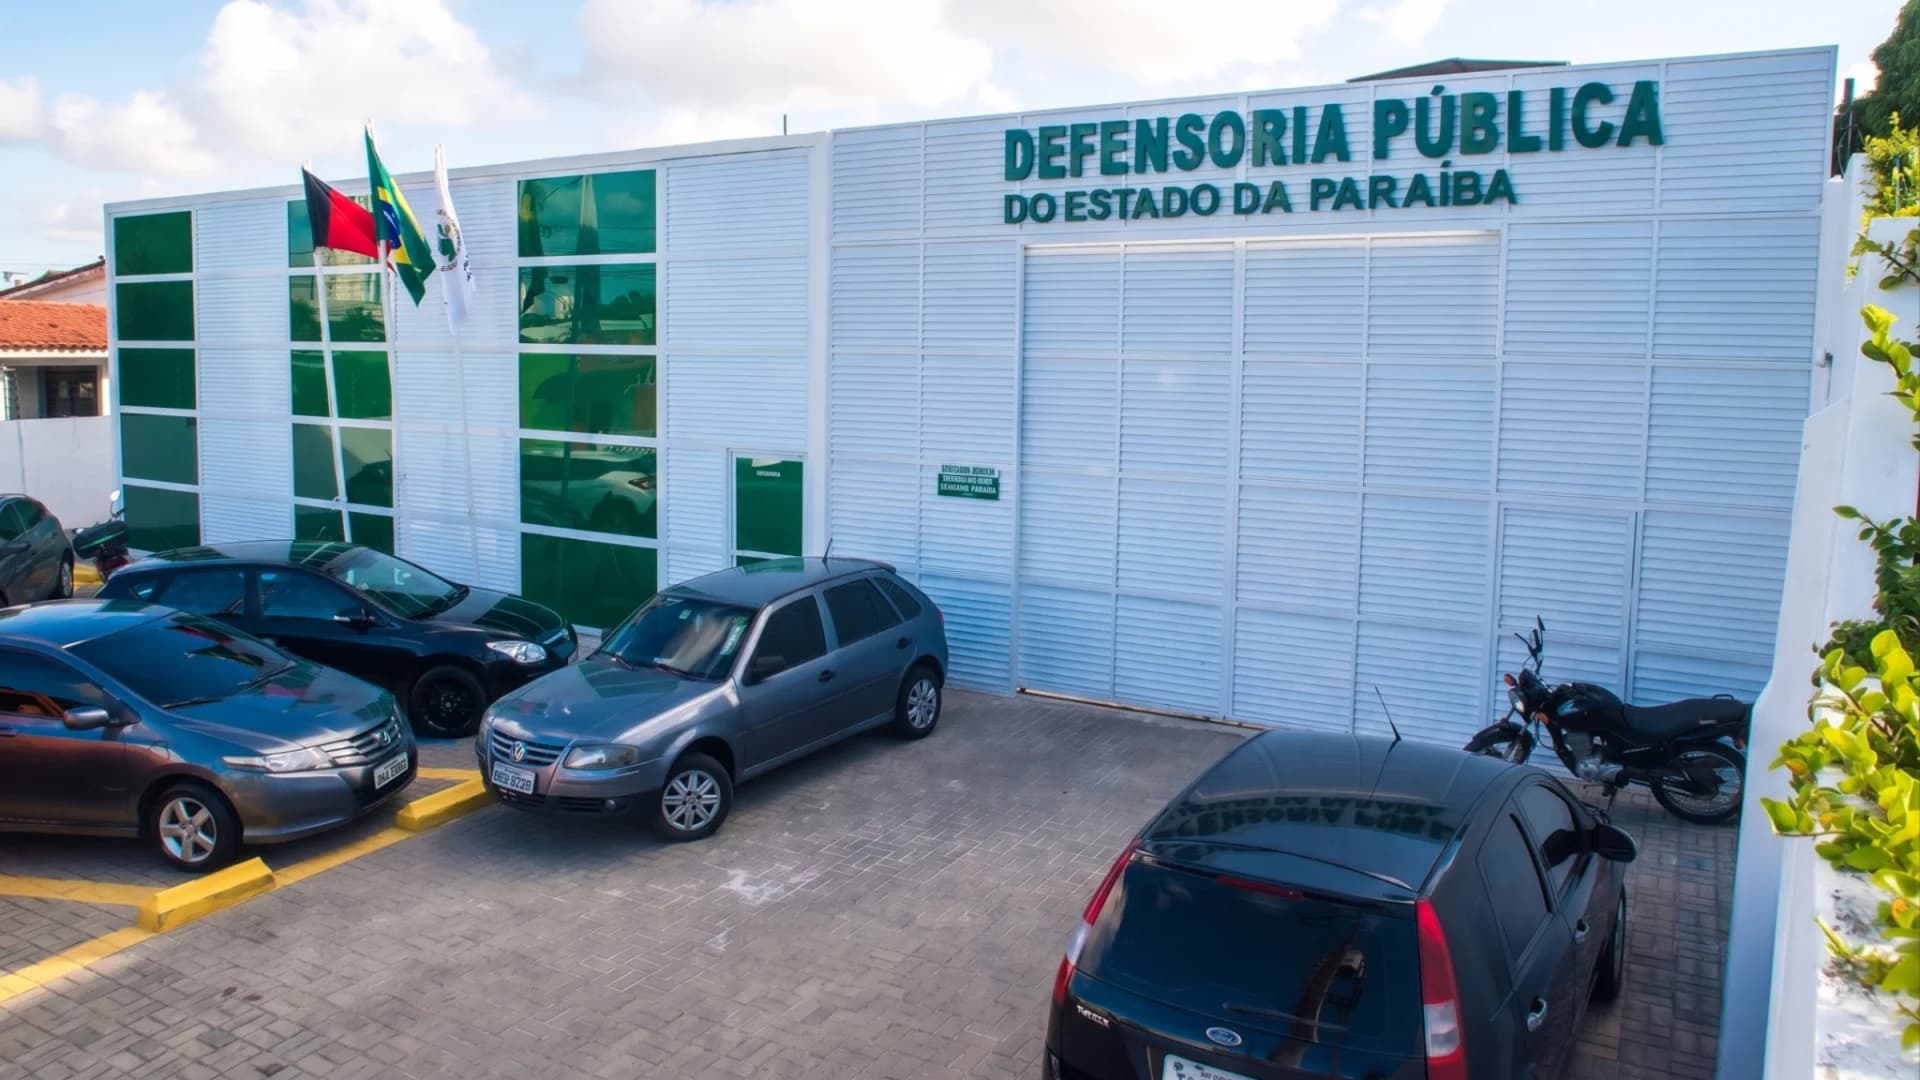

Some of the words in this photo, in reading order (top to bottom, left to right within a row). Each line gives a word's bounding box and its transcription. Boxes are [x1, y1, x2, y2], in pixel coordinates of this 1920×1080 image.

[1004, 104, 1350, 181] DEFENSORIA
[1373, 80, 1664, 160] PÚBLICA
[1004, 194, 1056, 224] DO
[1064, 183, 1220, 222] ESTADO
[1233, 180, 1292, 215] DA
[1310, 160, 1518, 211] PARAÍBA
